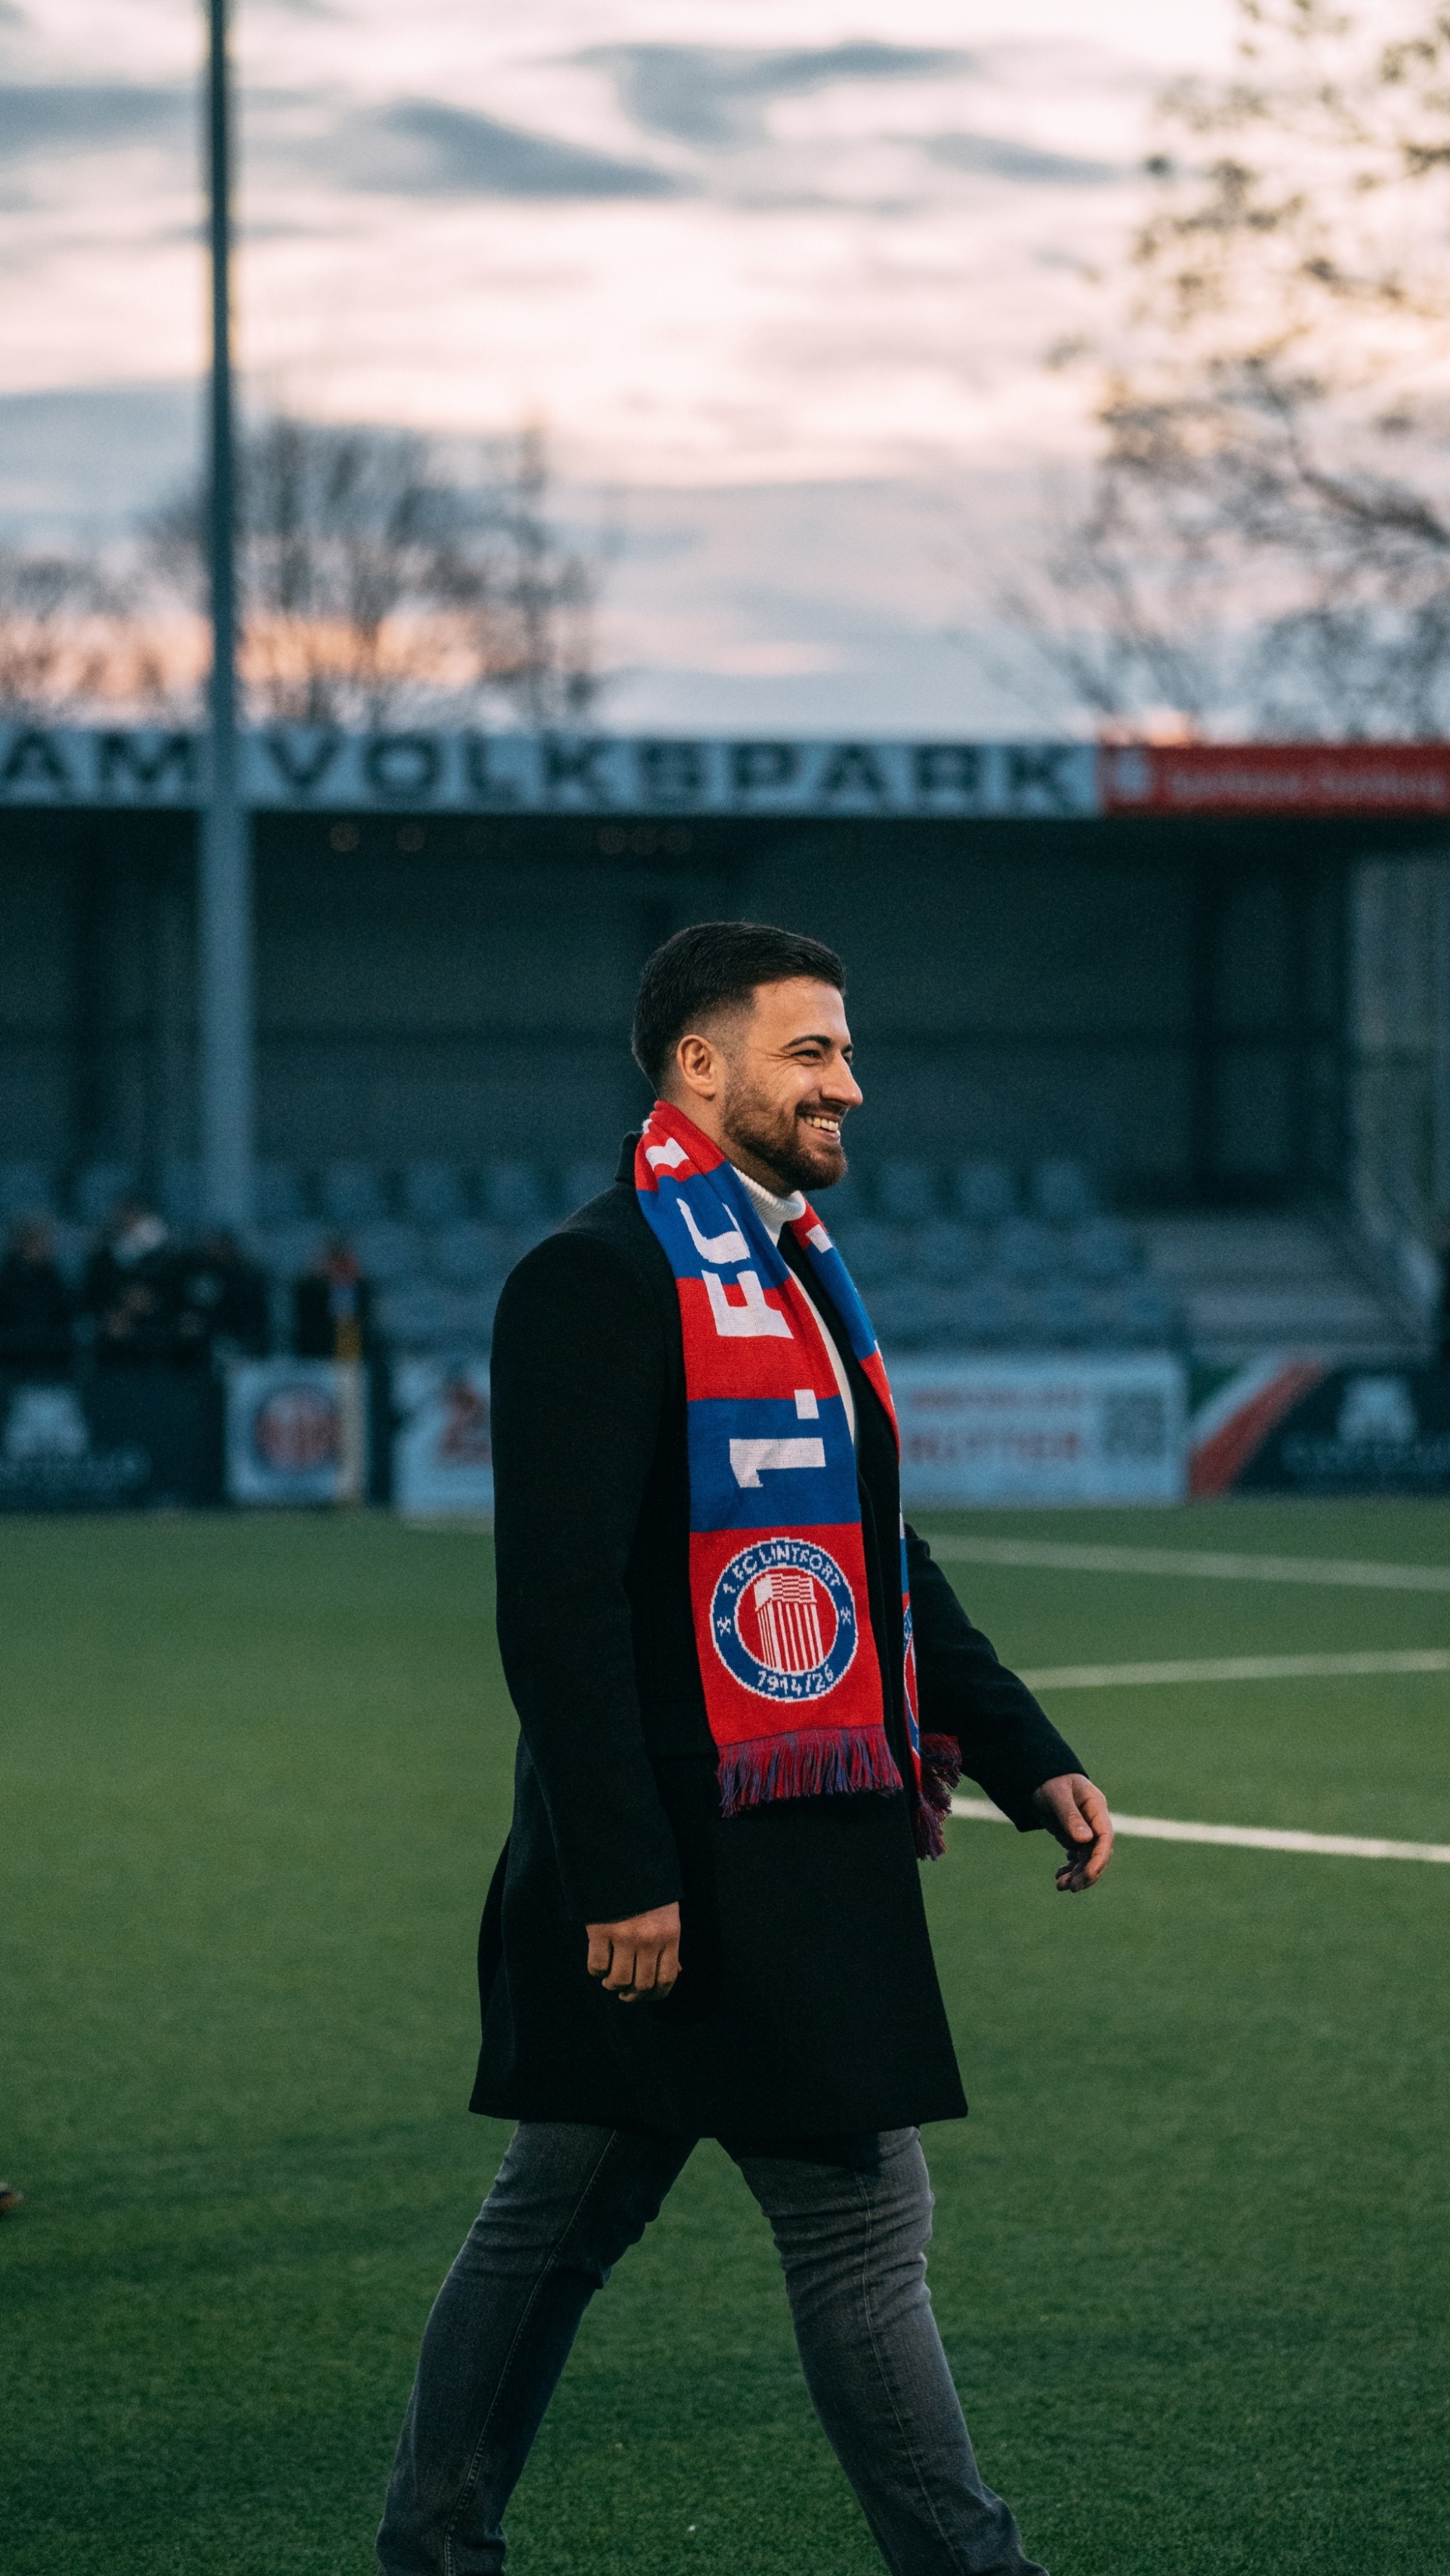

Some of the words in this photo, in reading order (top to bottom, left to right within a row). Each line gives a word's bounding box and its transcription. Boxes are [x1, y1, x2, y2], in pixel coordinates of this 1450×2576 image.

[0, 731, 198, 799] AM
[263, 737, 1075, 809] VOLKSPARK
[676, 1198, 794, 1339] FC
[732, 1555, 757, 1581] FC
[759, 1545, 841, 1586] LINTFORT
